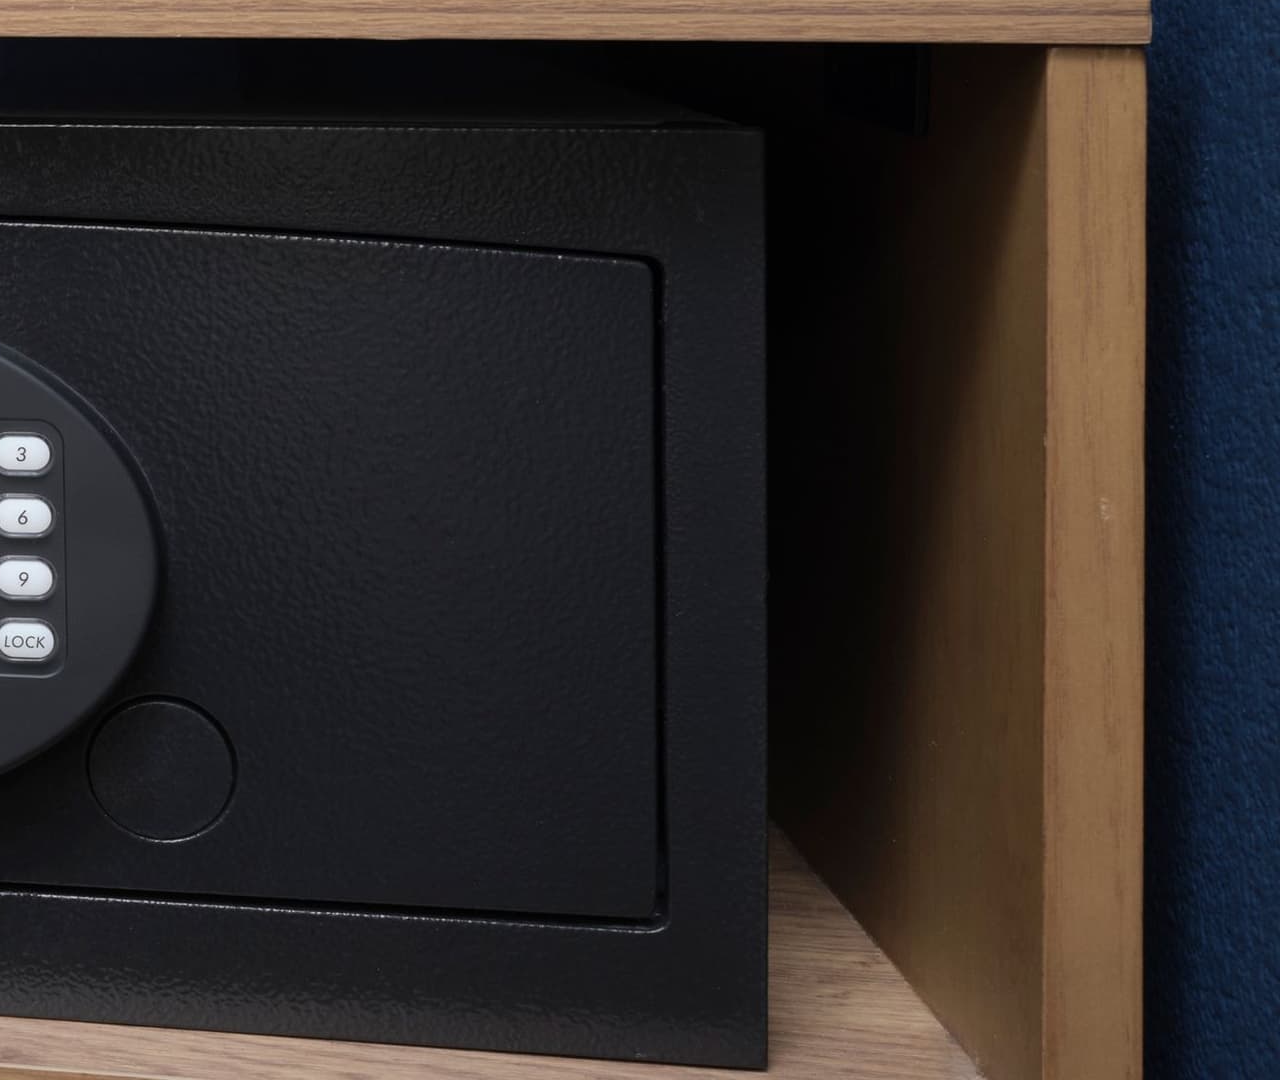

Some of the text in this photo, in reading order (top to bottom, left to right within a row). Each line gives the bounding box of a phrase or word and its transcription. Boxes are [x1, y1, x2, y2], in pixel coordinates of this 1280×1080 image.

[15, 446, 27, 462] 3
[17, 509, 29, 526] 6
[18, 571, 30, 587] 9
[4, 635, 46, 650] LOCK
